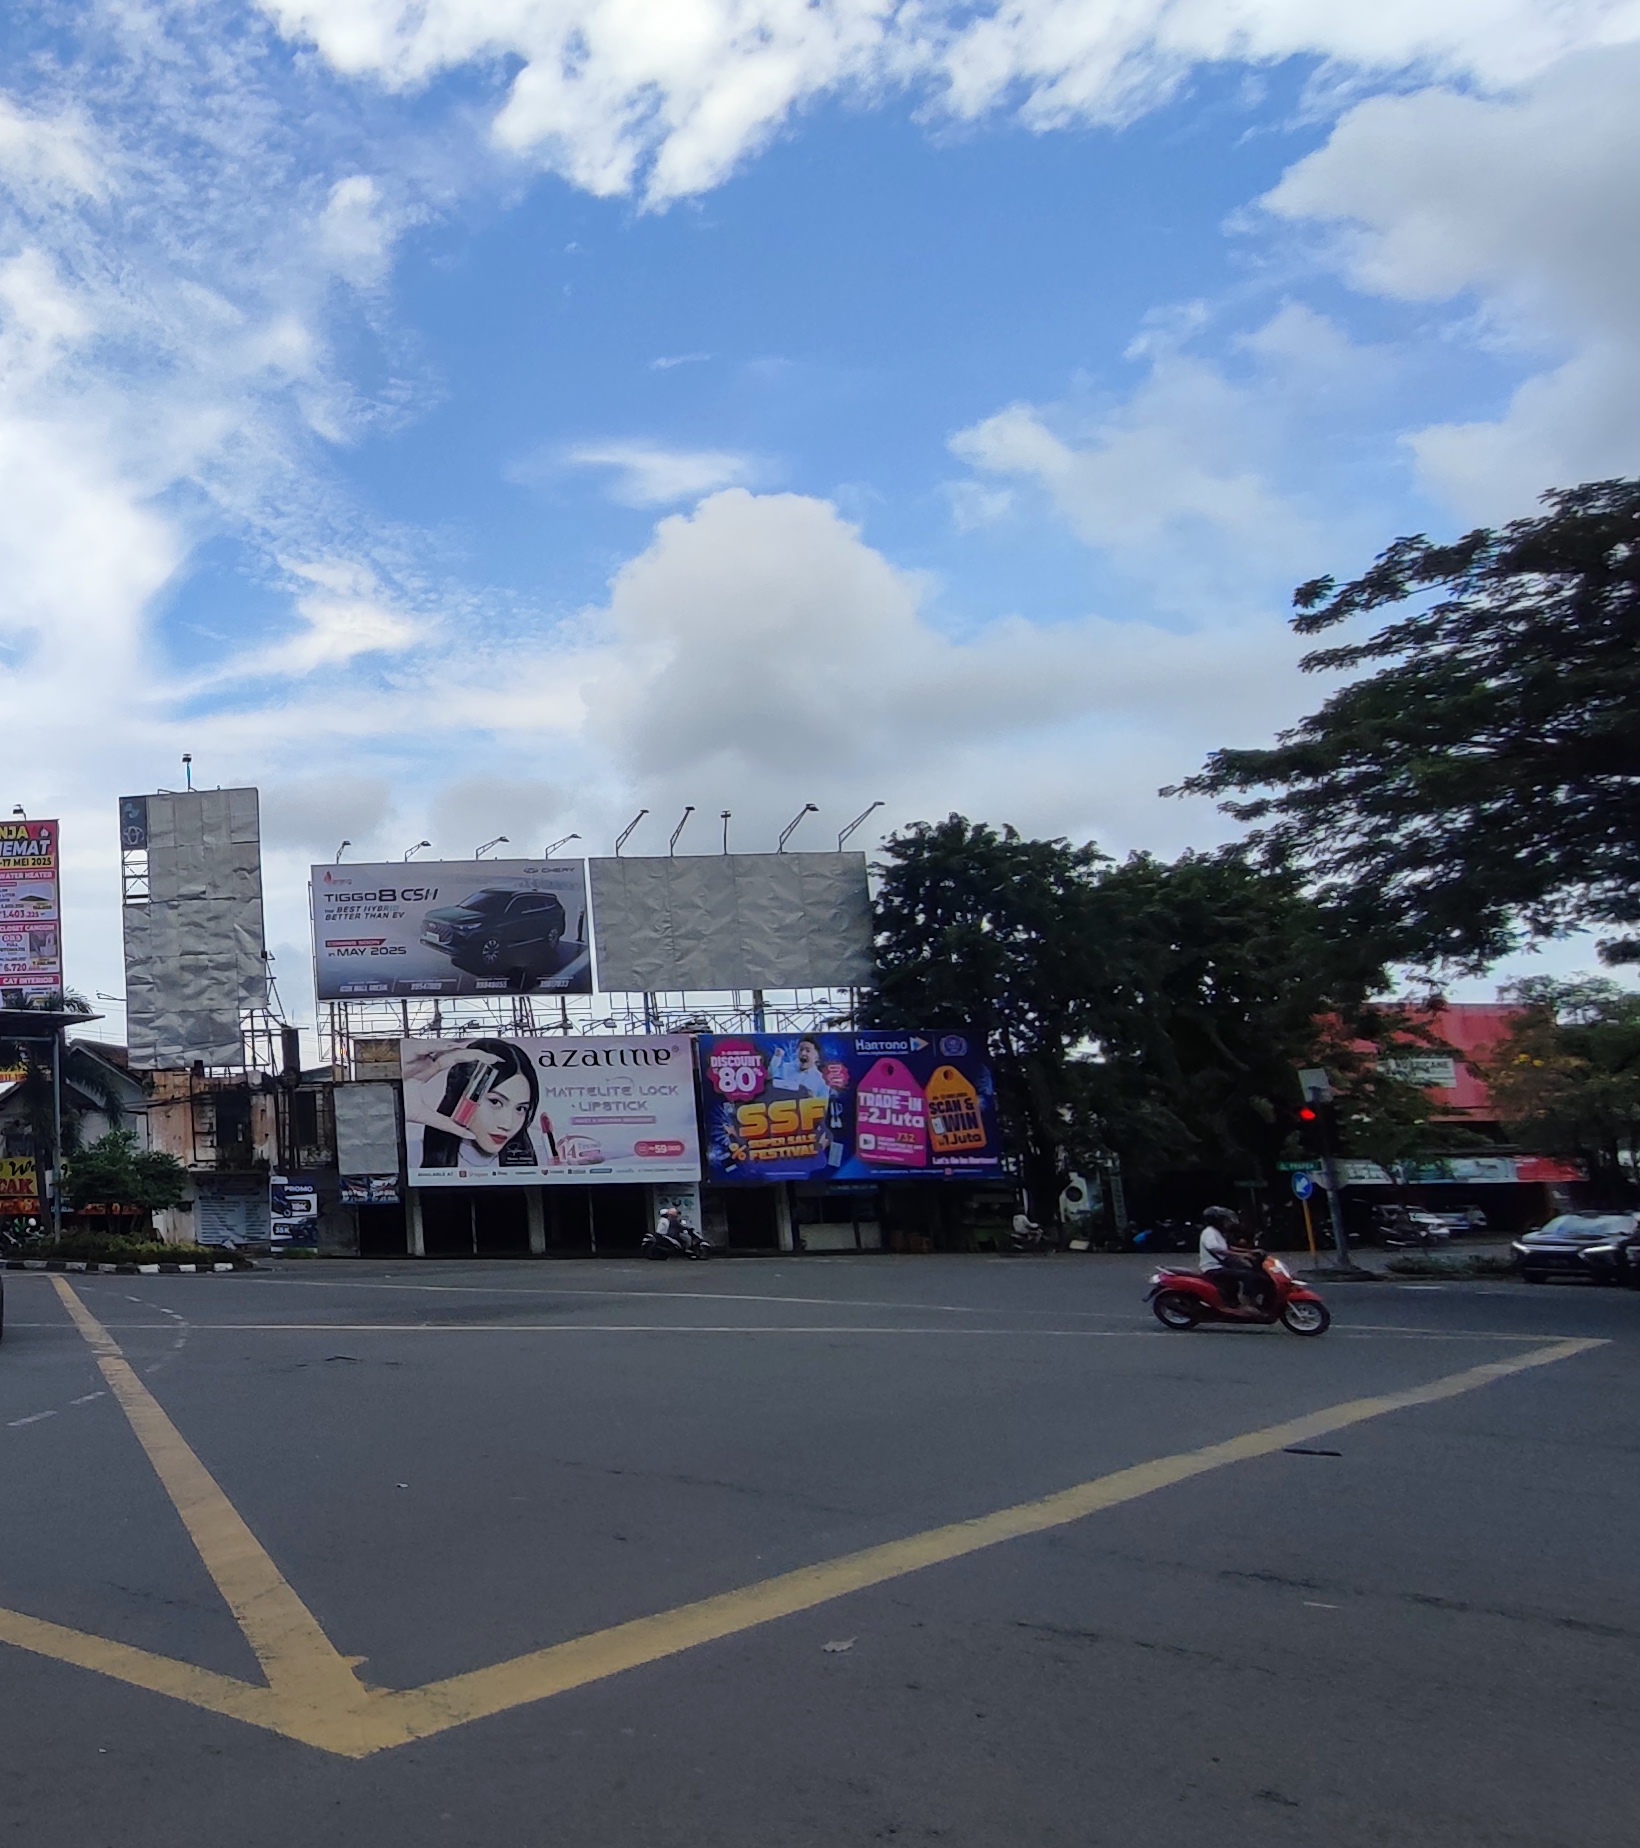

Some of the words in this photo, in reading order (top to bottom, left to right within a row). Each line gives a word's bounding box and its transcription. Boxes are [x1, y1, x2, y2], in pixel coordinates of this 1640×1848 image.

[13, 858, 29, 866] MEI
[32, 857, 52, 866] 2025
[24, 871, 53, 879] HEATER
[336, 905, 361, 913] BEST
[325, 913, 361, 921] BETTER
[336, 948, 366, 957] MAY
[370, 946, 407, 955] 2025
[538, 1048, 671, 1067] azarine
[710, 1056, 762, 1067] DISCOUNT
[545, 1086, 632, 1097] MATTELITE
[639, 1085, 679, 1096] LOCK
[579, 1101, 648, 1112] LIPSTICK
[858, 1092, 922, 1111] TRADE-IN
[929, 1099, 961, 1115] SCAN
[964, 1098, 974, 1110] &
[736, 1097, 829, 1138] SSF
[943, 1111, 979, 1133] WIN
[748, 1137, 786, 1149] SUPER
[787, 1134, 817, 1144] SALE
[749, 1145, 819, 1160] FESTIVAL
